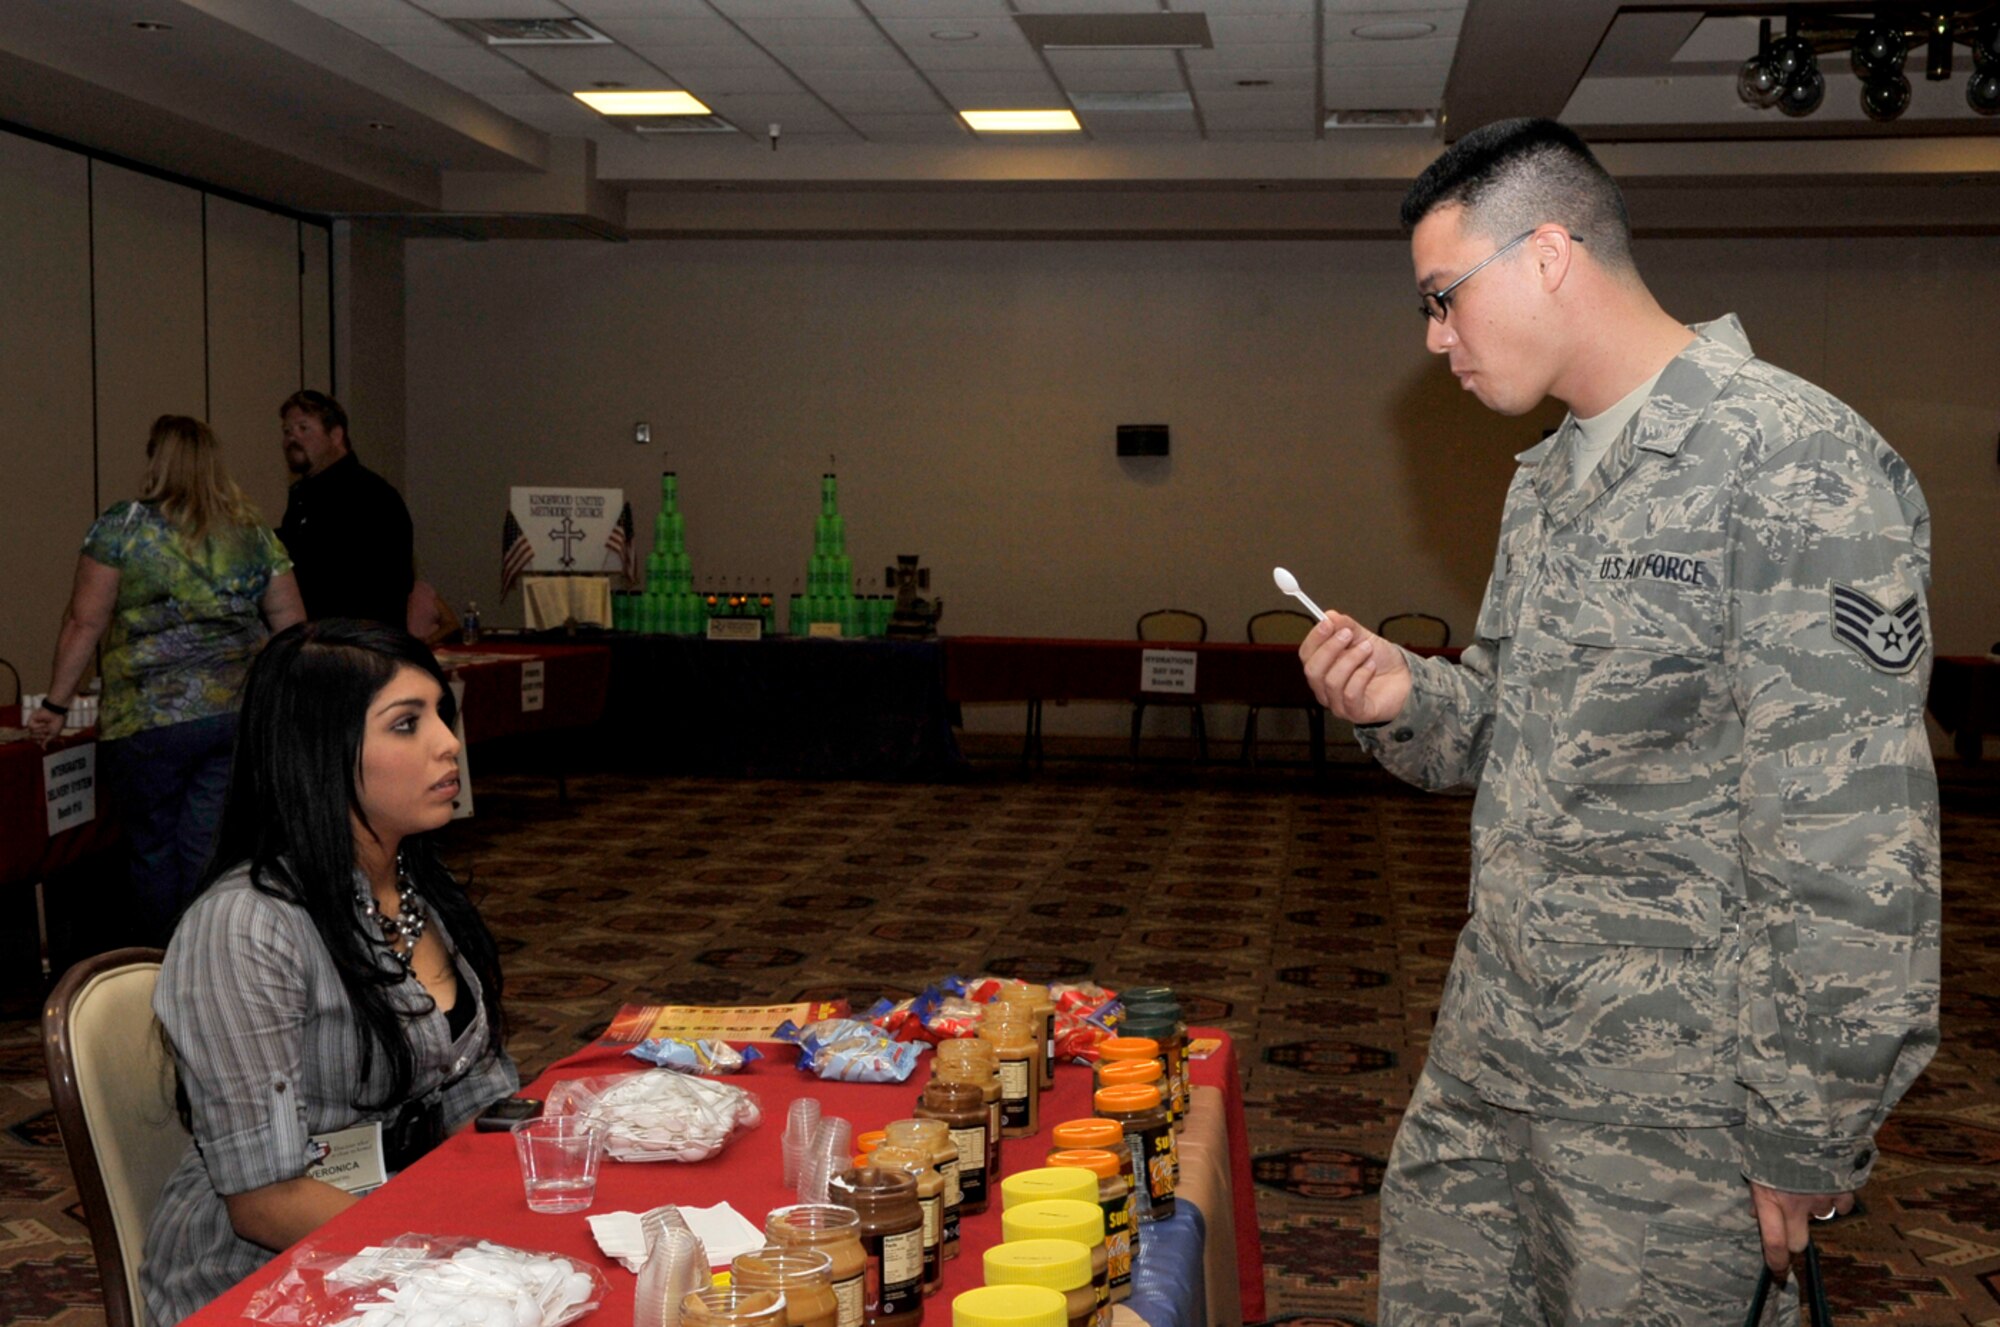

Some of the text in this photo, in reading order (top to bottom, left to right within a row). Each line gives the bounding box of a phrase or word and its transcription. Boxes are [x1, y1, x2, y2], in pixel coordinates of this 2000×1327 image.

[575, 495, 605, 506] UNITED
[530, 507, 604, 518] METHODIST CHURCH
[1599, 556, 1622, 580] U.S.
[1643, 553, 1706, 585] FORCE
[311, 1161, 360, 1178] VERONICA
